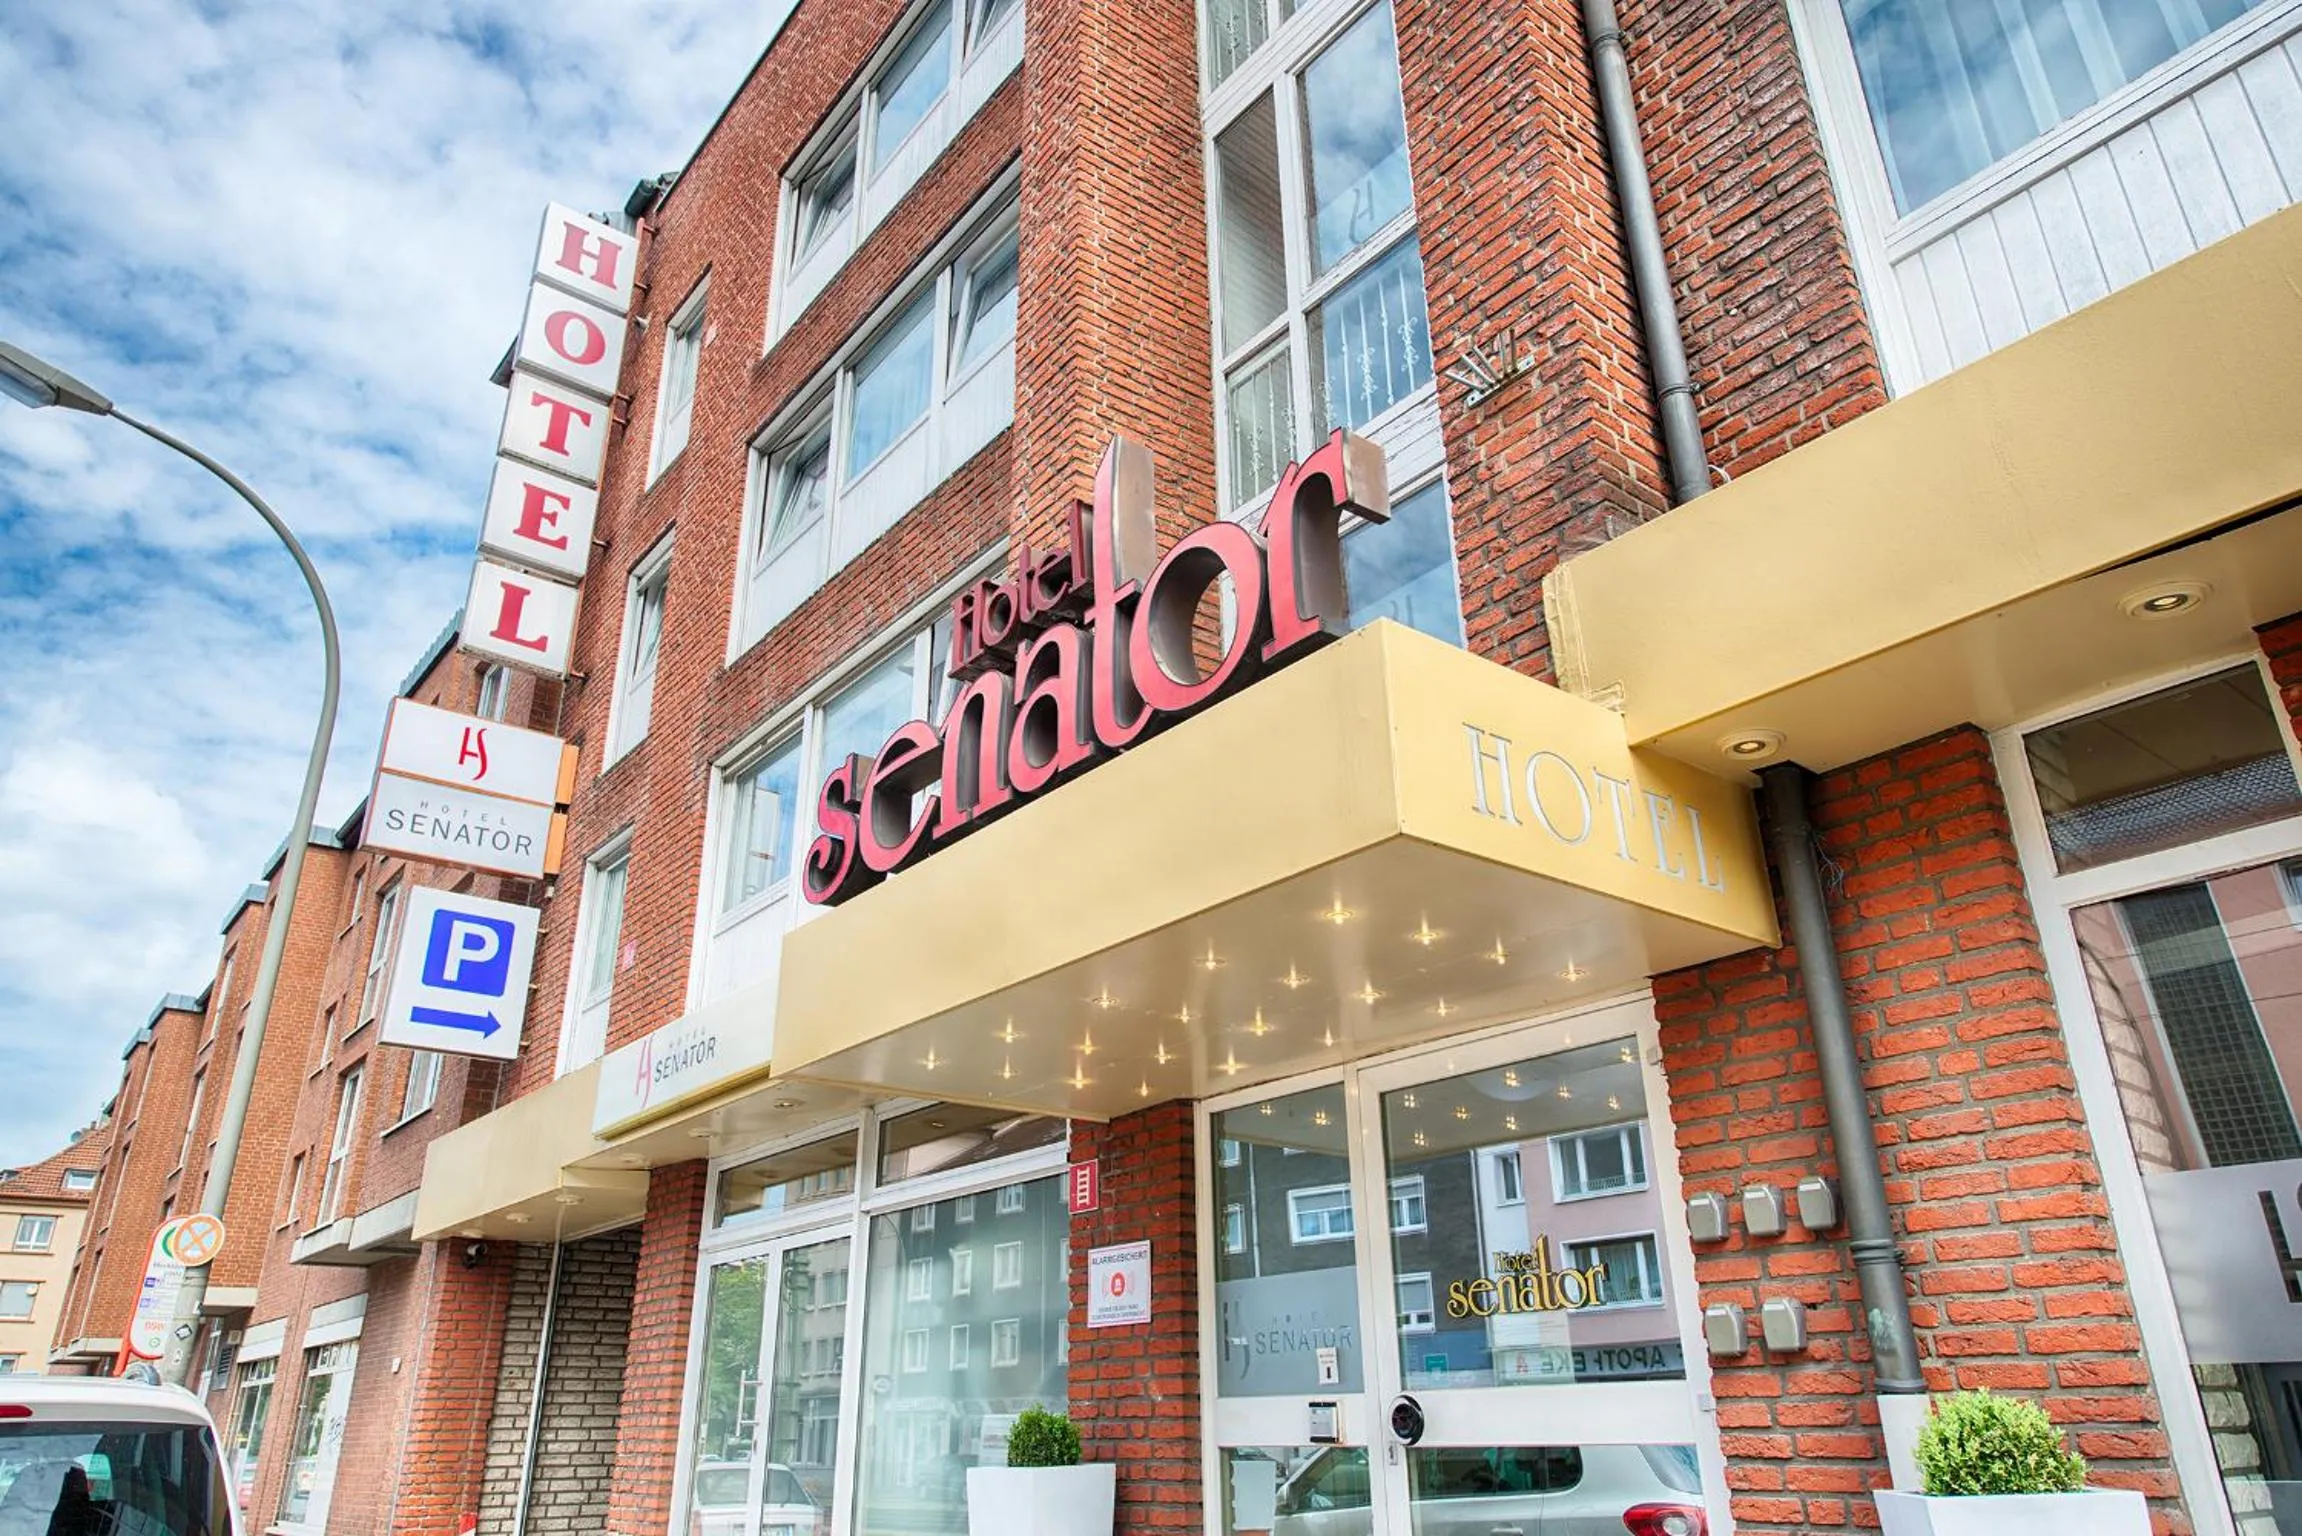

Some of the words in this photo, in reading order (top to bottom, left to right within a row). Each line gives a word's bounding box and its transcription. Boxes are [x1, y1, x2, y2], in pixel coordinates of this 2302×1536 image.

[489, 221, 624, 653] HOTEL
[949, 499, 1091, 677] Hotel
[803, 426, 1354, 906] senator
[385, 809, 532, 856] SENATOR
[420, 800, 506, 826] HOTEL
[1462, 722, 1726, 895] HOTEL
[443, 919, 499, 982] P
[654, 1036, 717, 1083] SENATOR
[1446, 1232, 1607, 1318] senator
[1255, 1325, 1352, 1355] SENATOR
